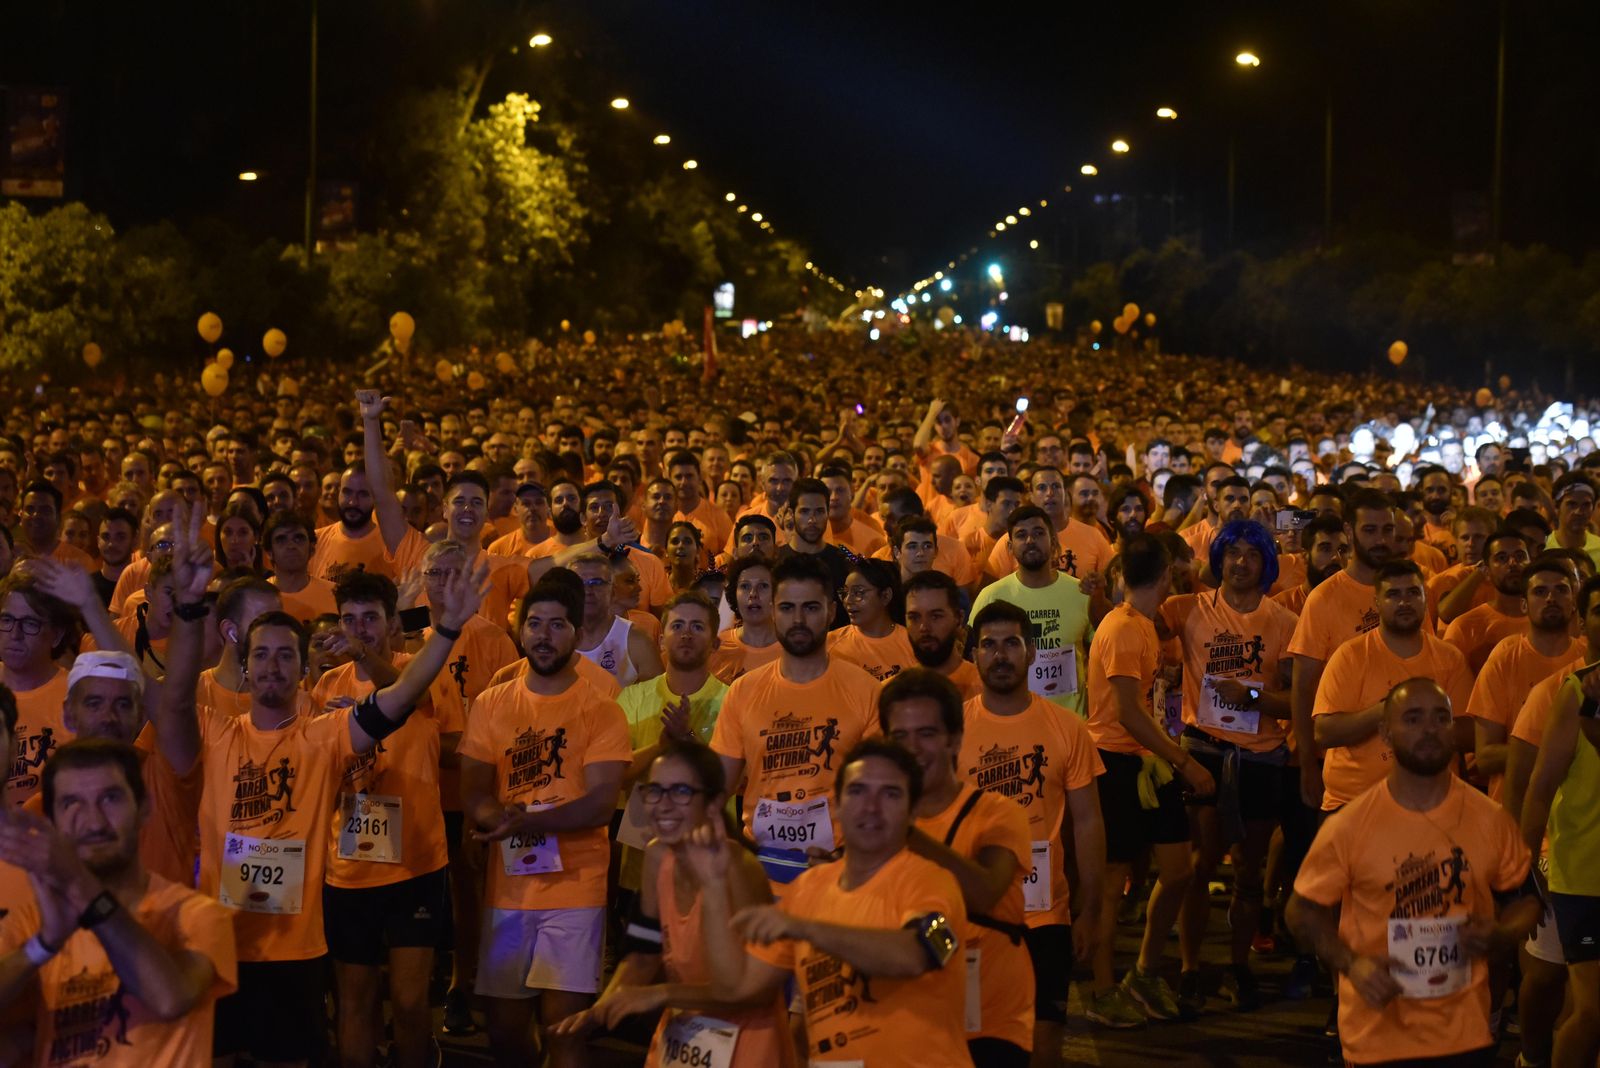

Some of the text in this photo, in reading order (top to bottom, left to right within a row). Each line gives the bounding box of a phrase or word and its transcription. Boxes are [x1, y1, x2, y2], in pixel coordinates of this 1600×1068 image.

[1031, 609, 1060, 619] CARRERA
[1209, 643, 1244, 659] CARRERA
[1035, 664, 1063, 680] 9121
[1206, 656, 1246, 674] NOCTURNA
[766, 730, 812, 751] CARRERA
[977, 759, 1021, 789] CARRERA
[235, 775, 268, 800] ARRERA
[231, 797, 272, 821] OCTURNA
[347, 817, 388, 836] 23161
[768, 822, 816, 842] 14997
[240, 863, 284, 885] 9792
[1414, 945, 1458, 967] 6764
